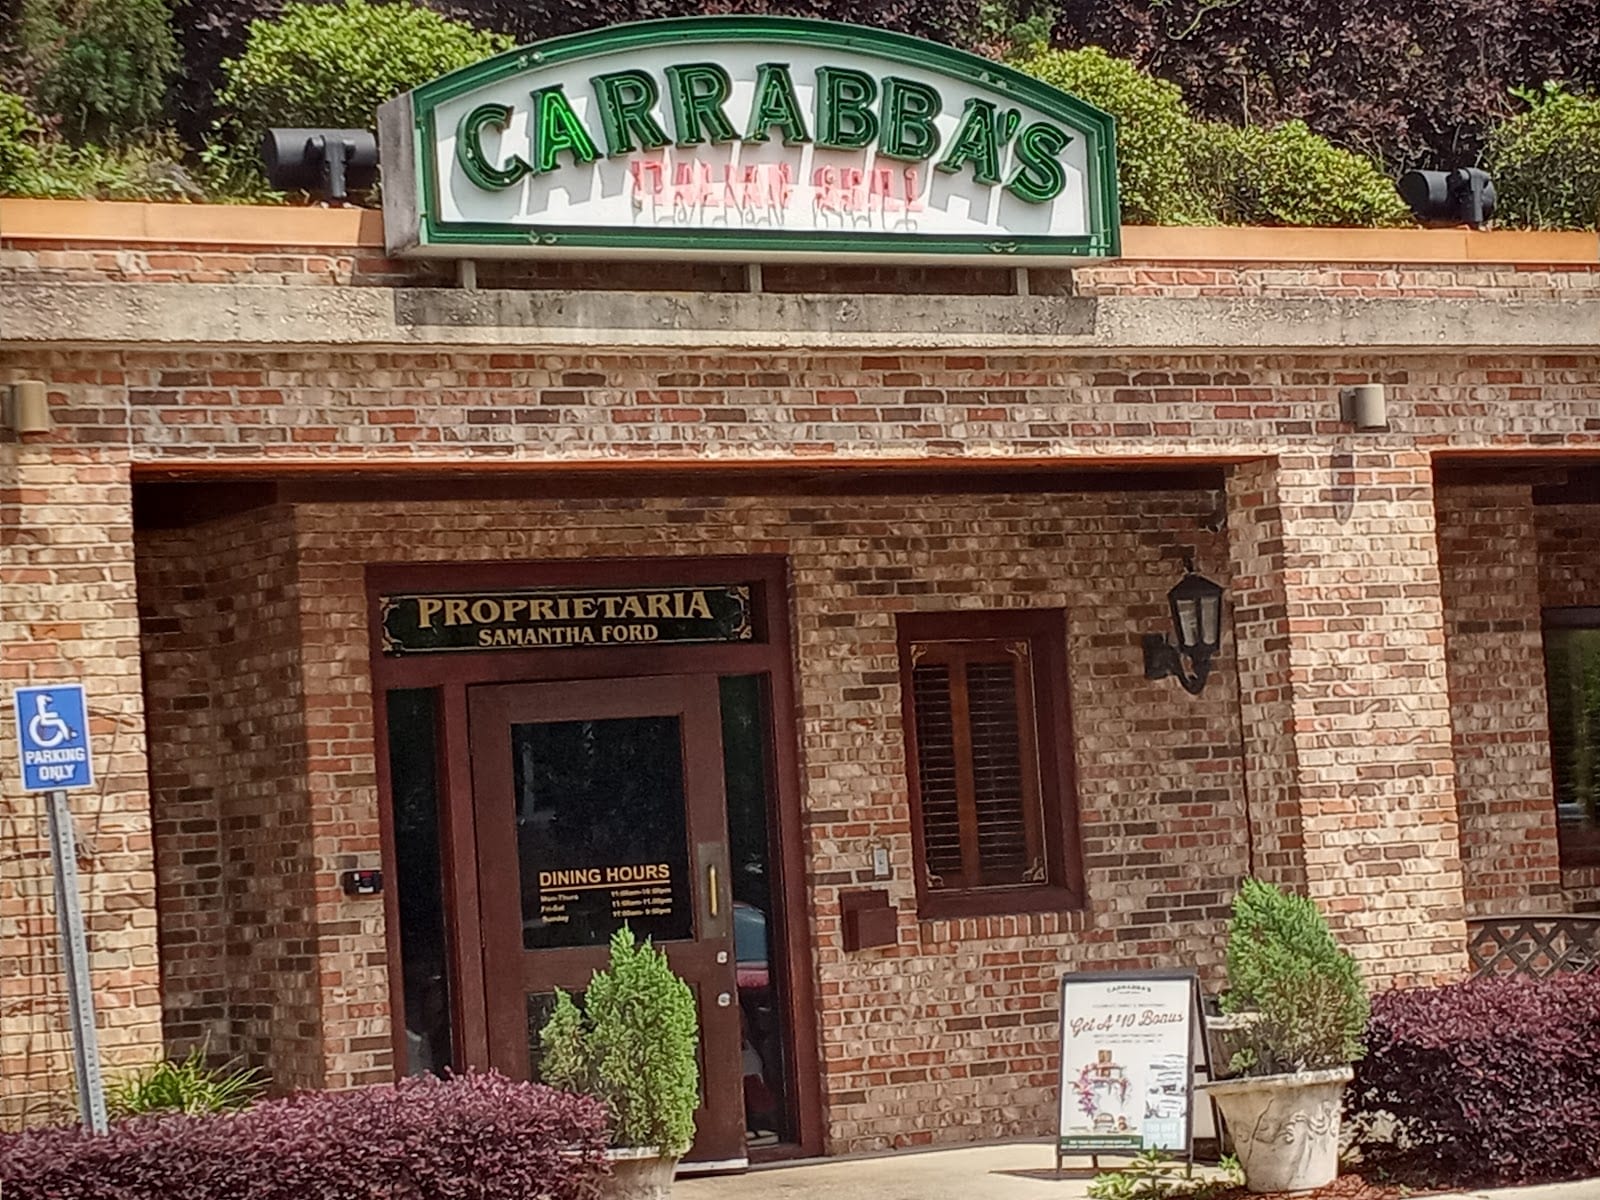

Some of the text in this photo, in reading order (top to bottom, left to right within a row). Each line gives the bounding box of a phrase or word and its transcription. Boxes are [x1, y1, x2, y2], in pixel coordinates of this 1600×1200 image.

[455, 61, 1073, 204] CARRABBA'S
[417, 591, 714, 628] PROPRIETARIA
[478, 623, 659, 646] SAMANTHA FORD
[25, 747, 86, 765] PARKING
[39, 764, 76, 781] ONLY
[539, 864, 670, 886] DINING HOURS
[1070, 1009, 1185, 1038] Get A $10 Bonus
